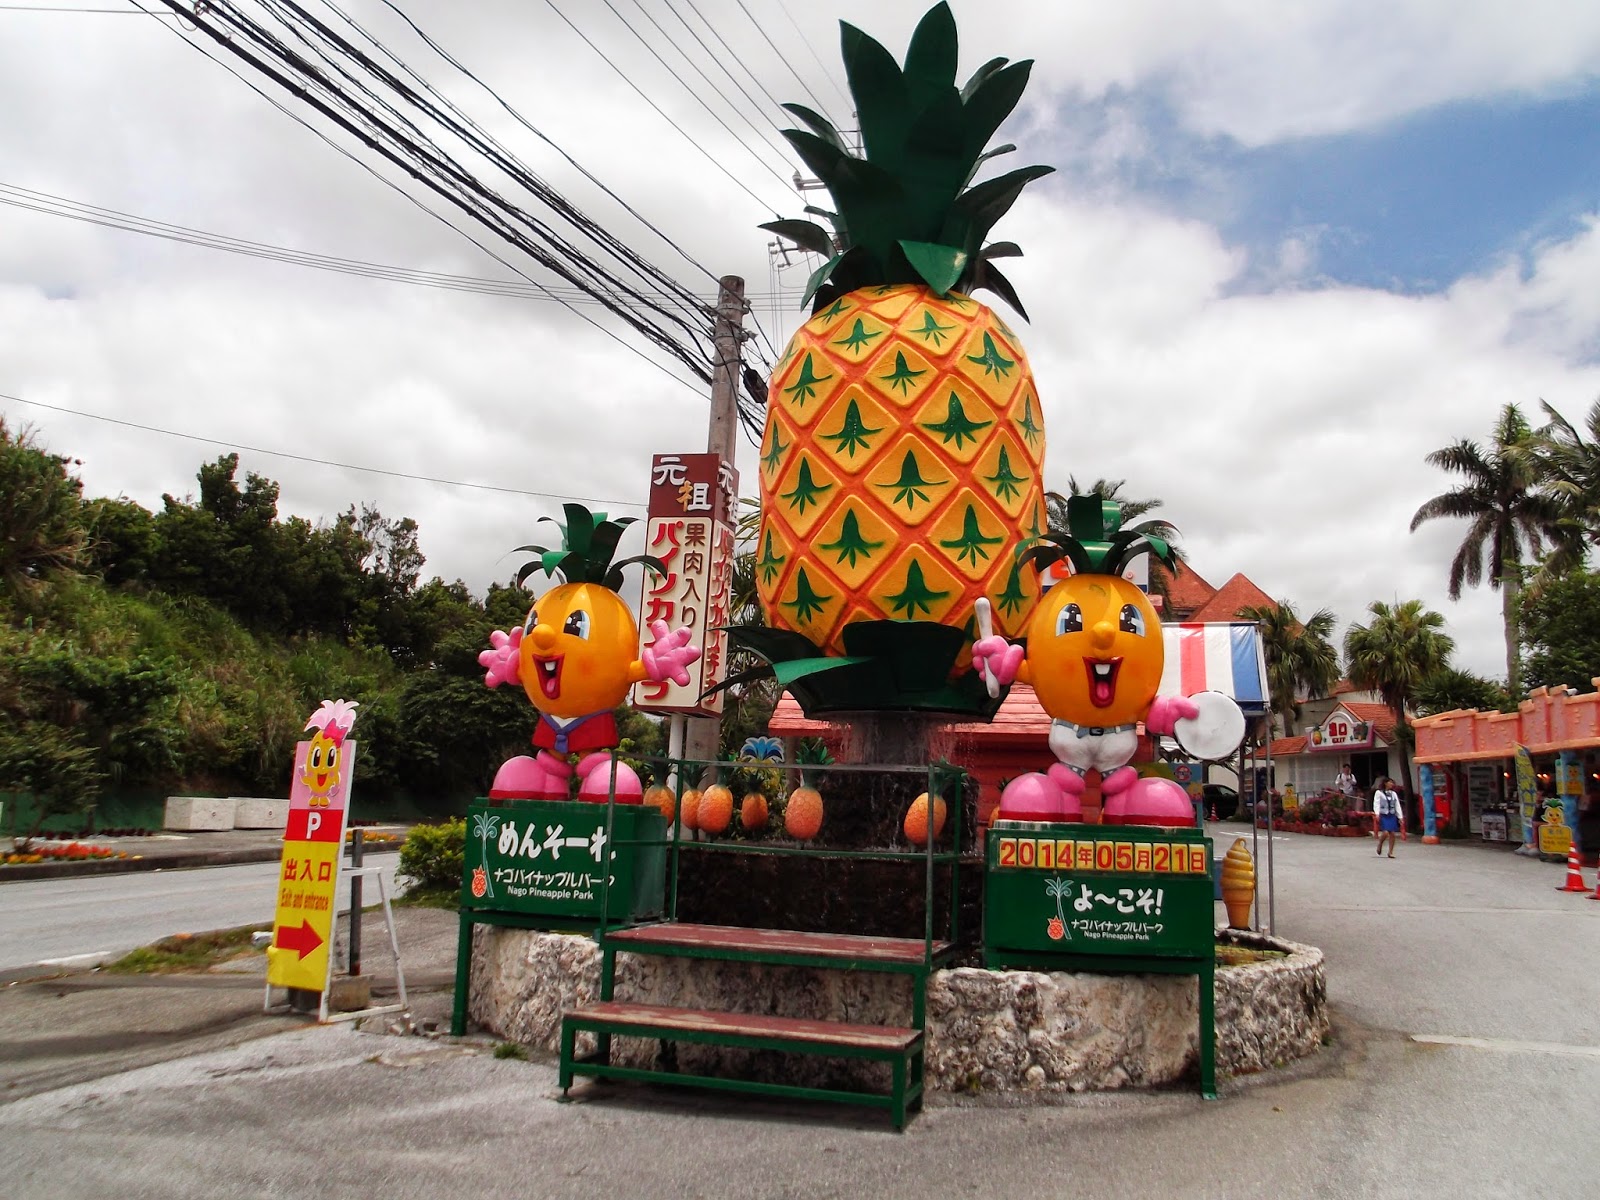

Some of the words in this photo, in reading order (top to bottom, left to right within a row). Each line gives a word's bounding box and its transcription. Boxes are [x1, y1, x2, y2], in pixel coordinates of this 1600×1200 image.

[652, 456, 713, 512] 元祖
[679, 523, 706, 628] 果肉入り
[306, 811, 322, 840] P
[498, 820, 617, 862] めんそーれ
[283, 857, 332, 882] 出入口
[293, 889, 305, 909] and
[304, 892, 329, 911] entrance
[507, 884, 528, 897] Nago
[529, 886, 572, 900] Pineapple
[573, 889, 594, 900] Park
[1083, 930, 1101, 939] Nago
[1101, 931, 1134, 940] Pineapple
[1135, 933, 1150, 941] Park
